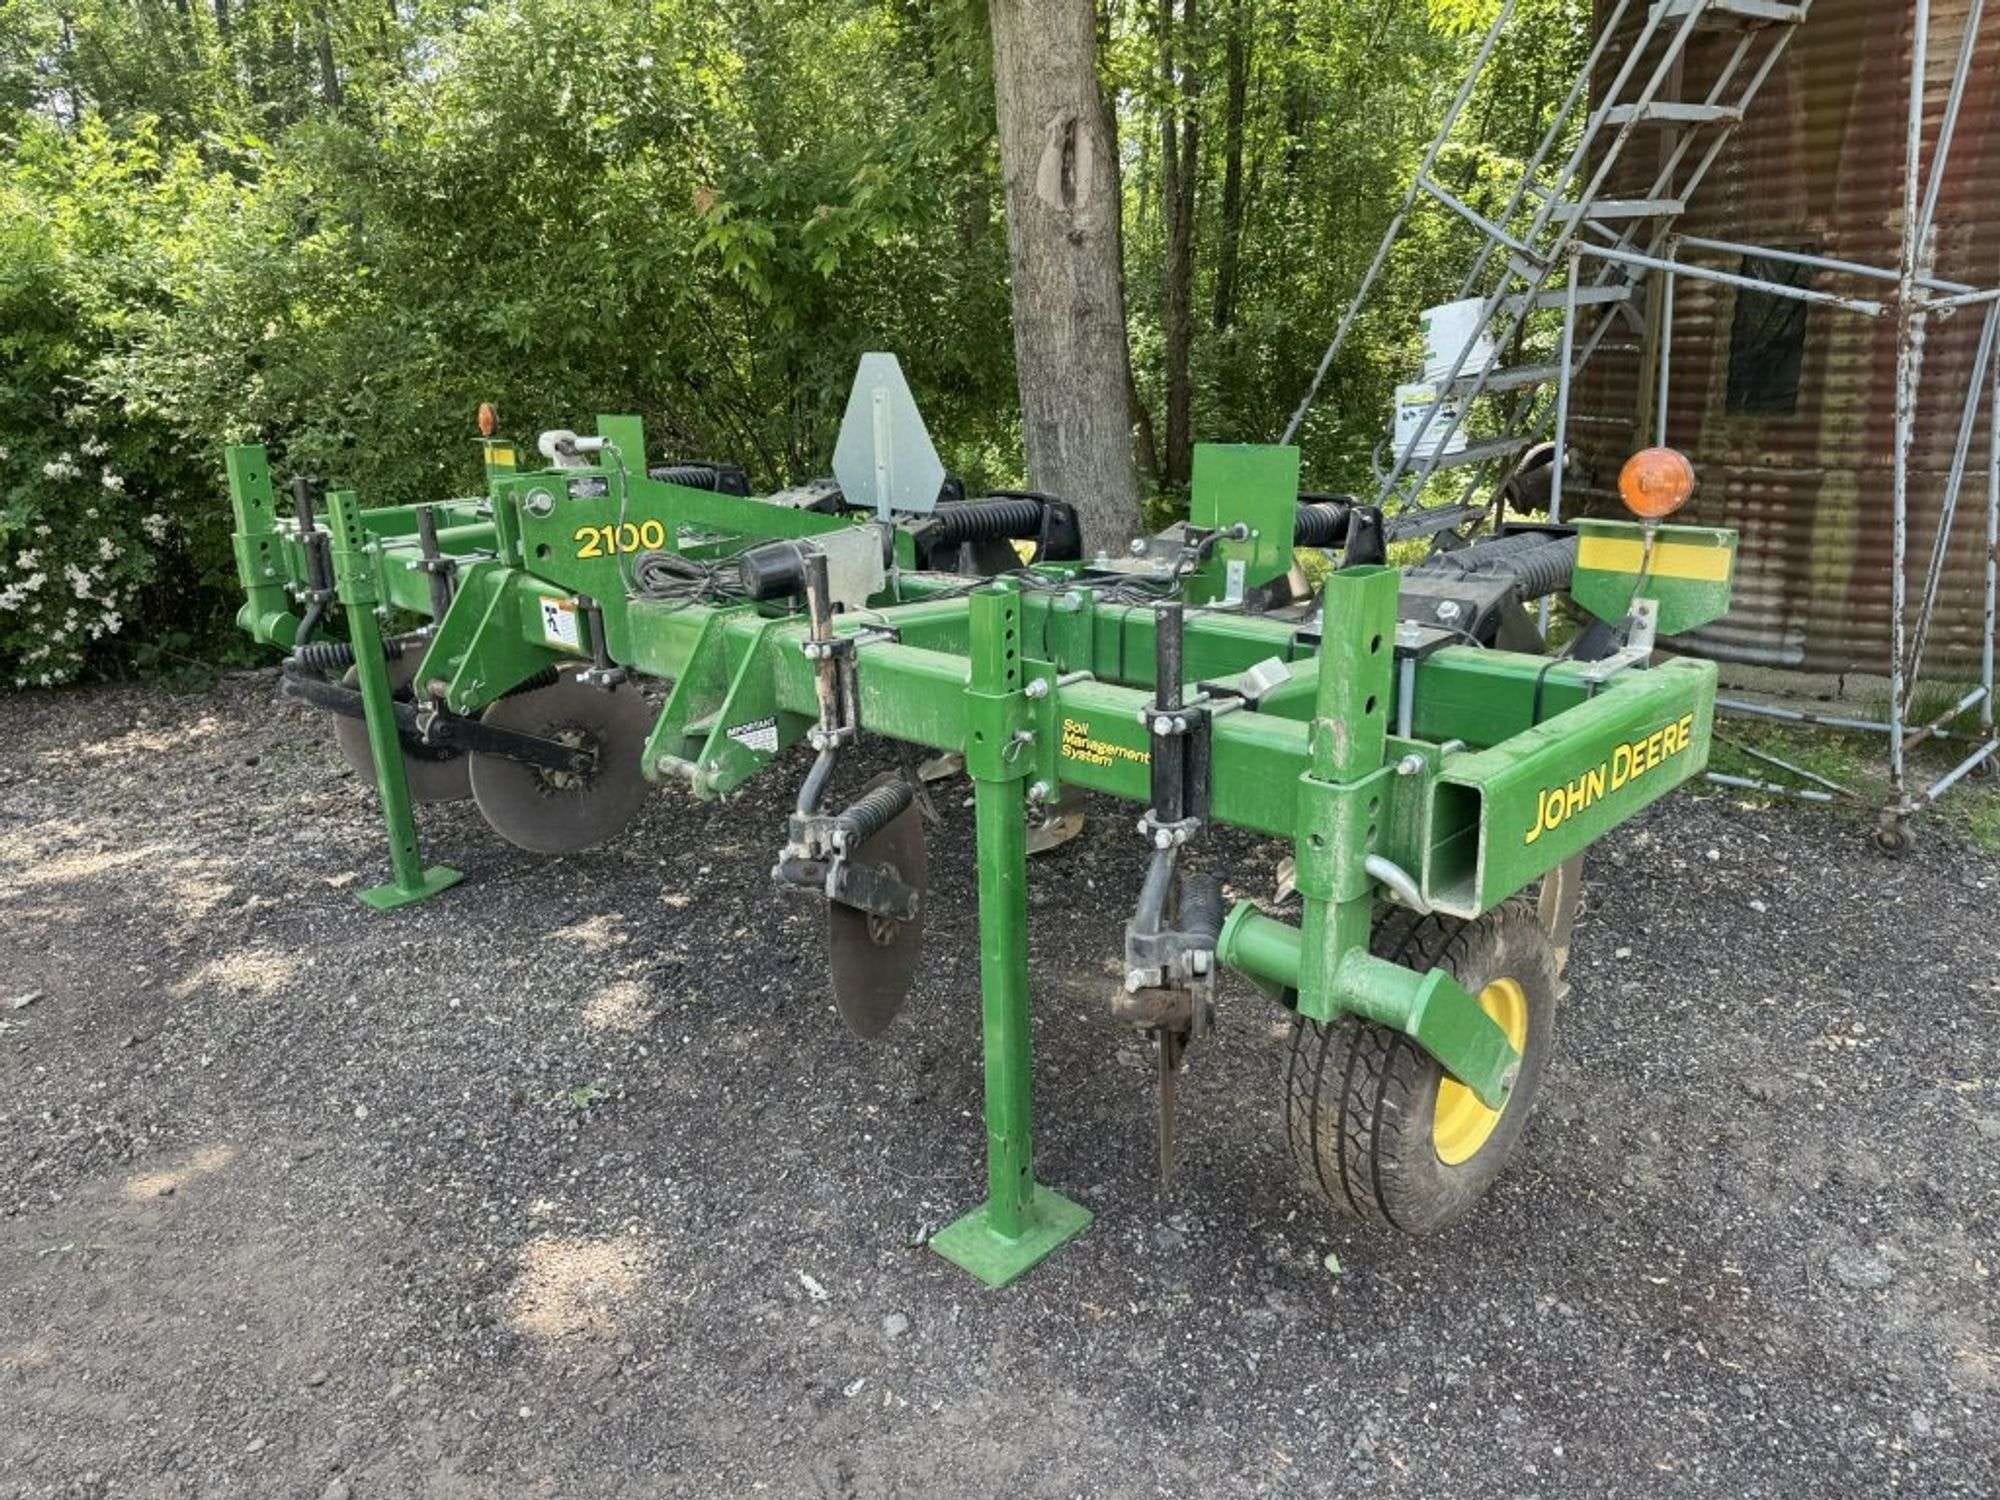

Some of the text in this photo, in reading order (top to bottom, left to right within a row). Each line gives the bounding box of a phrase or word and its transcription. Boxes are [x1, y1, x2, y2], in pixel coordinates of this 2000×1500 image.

[574, 519, 665, 558] 2100
[1063, 718, 1089, 734] Soil
[1061, 744, 1113, 767] System
[1062, 732, 1151, 765] Management
[1525, 713, 1695, 844] JOHN DEERE
